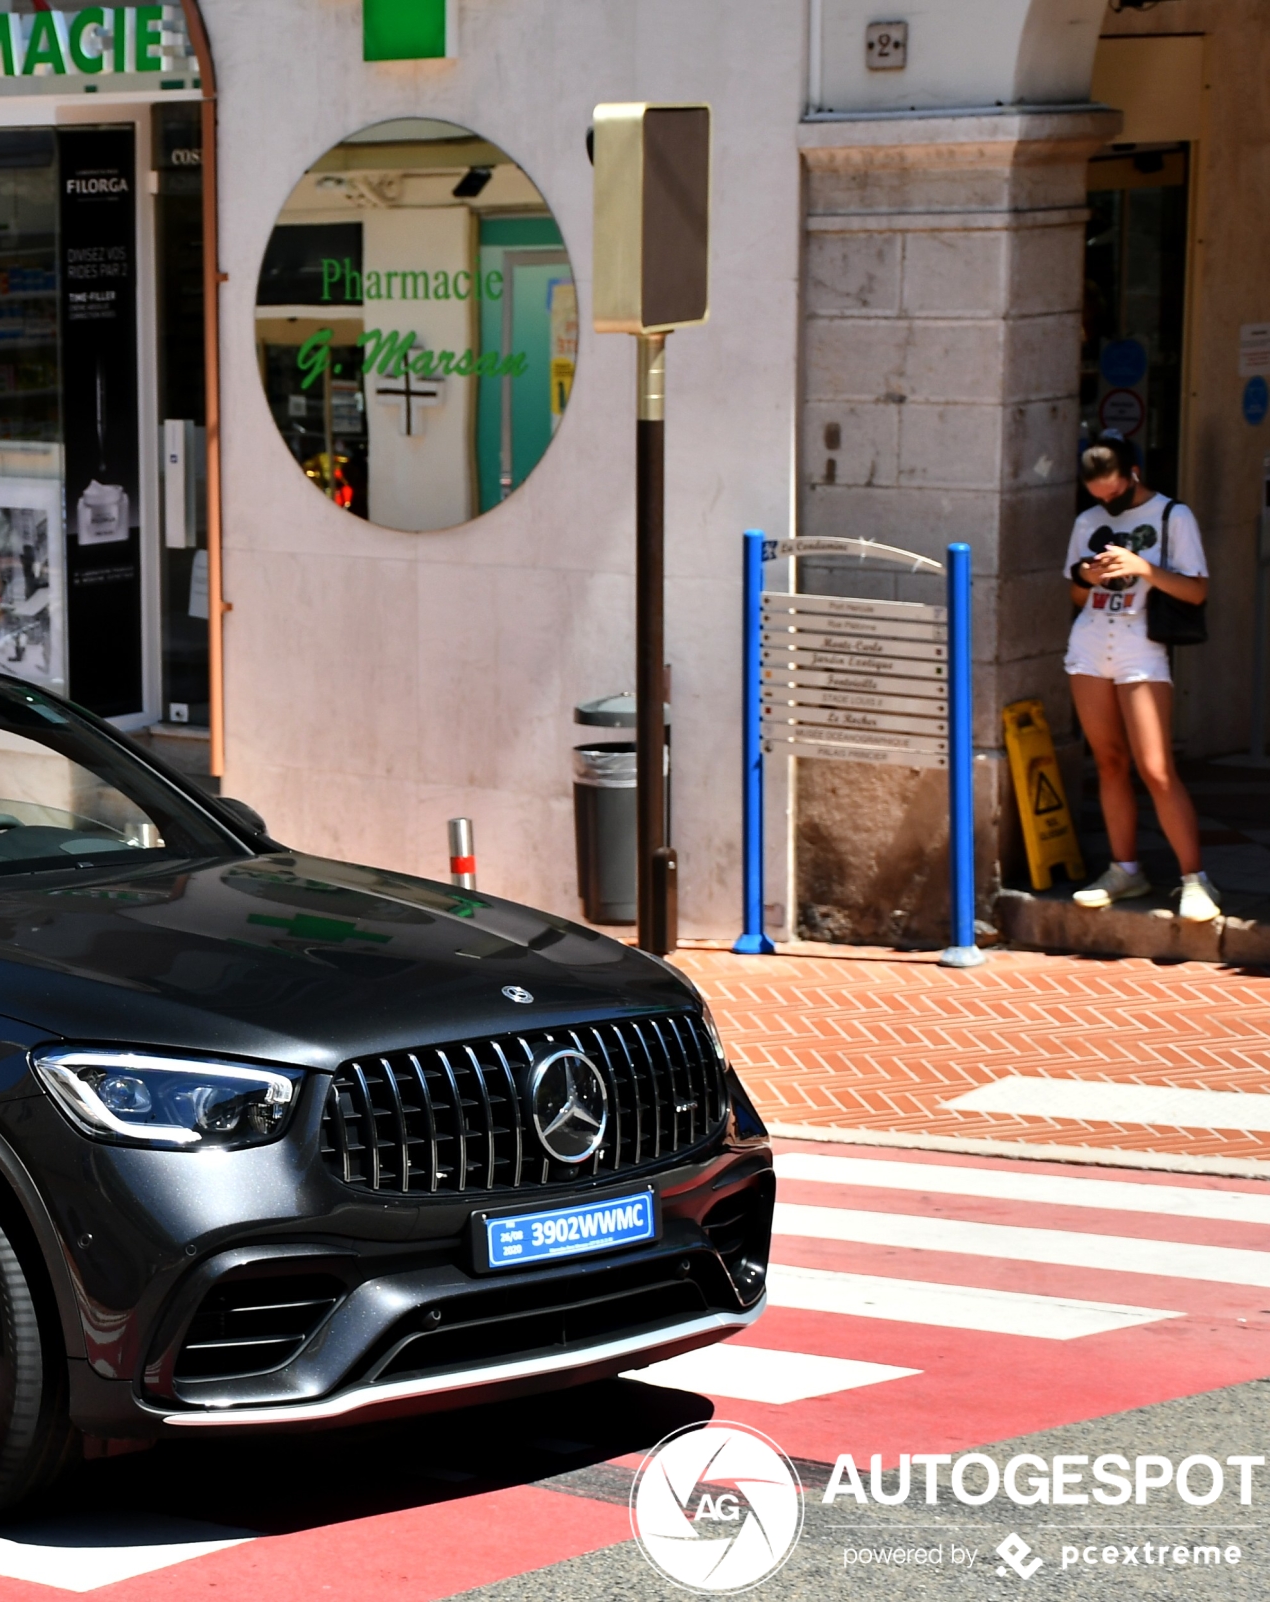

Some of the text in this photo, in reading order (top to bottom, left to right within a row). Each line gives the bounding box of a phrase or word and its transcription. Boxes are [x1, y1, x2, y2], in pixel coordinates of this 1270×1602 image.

[878, 34, 890, 57] 2
[66, 178, 129, 194] FILORGA
[320, 256, 504, 300] Pharmacie
[297, 328, 342, 390] G.
[357, 328, 528, 378] Marsan
[531, 1203, 644, 1247] 3902WWMC
[502, 1244, 523, 1256] 2020
